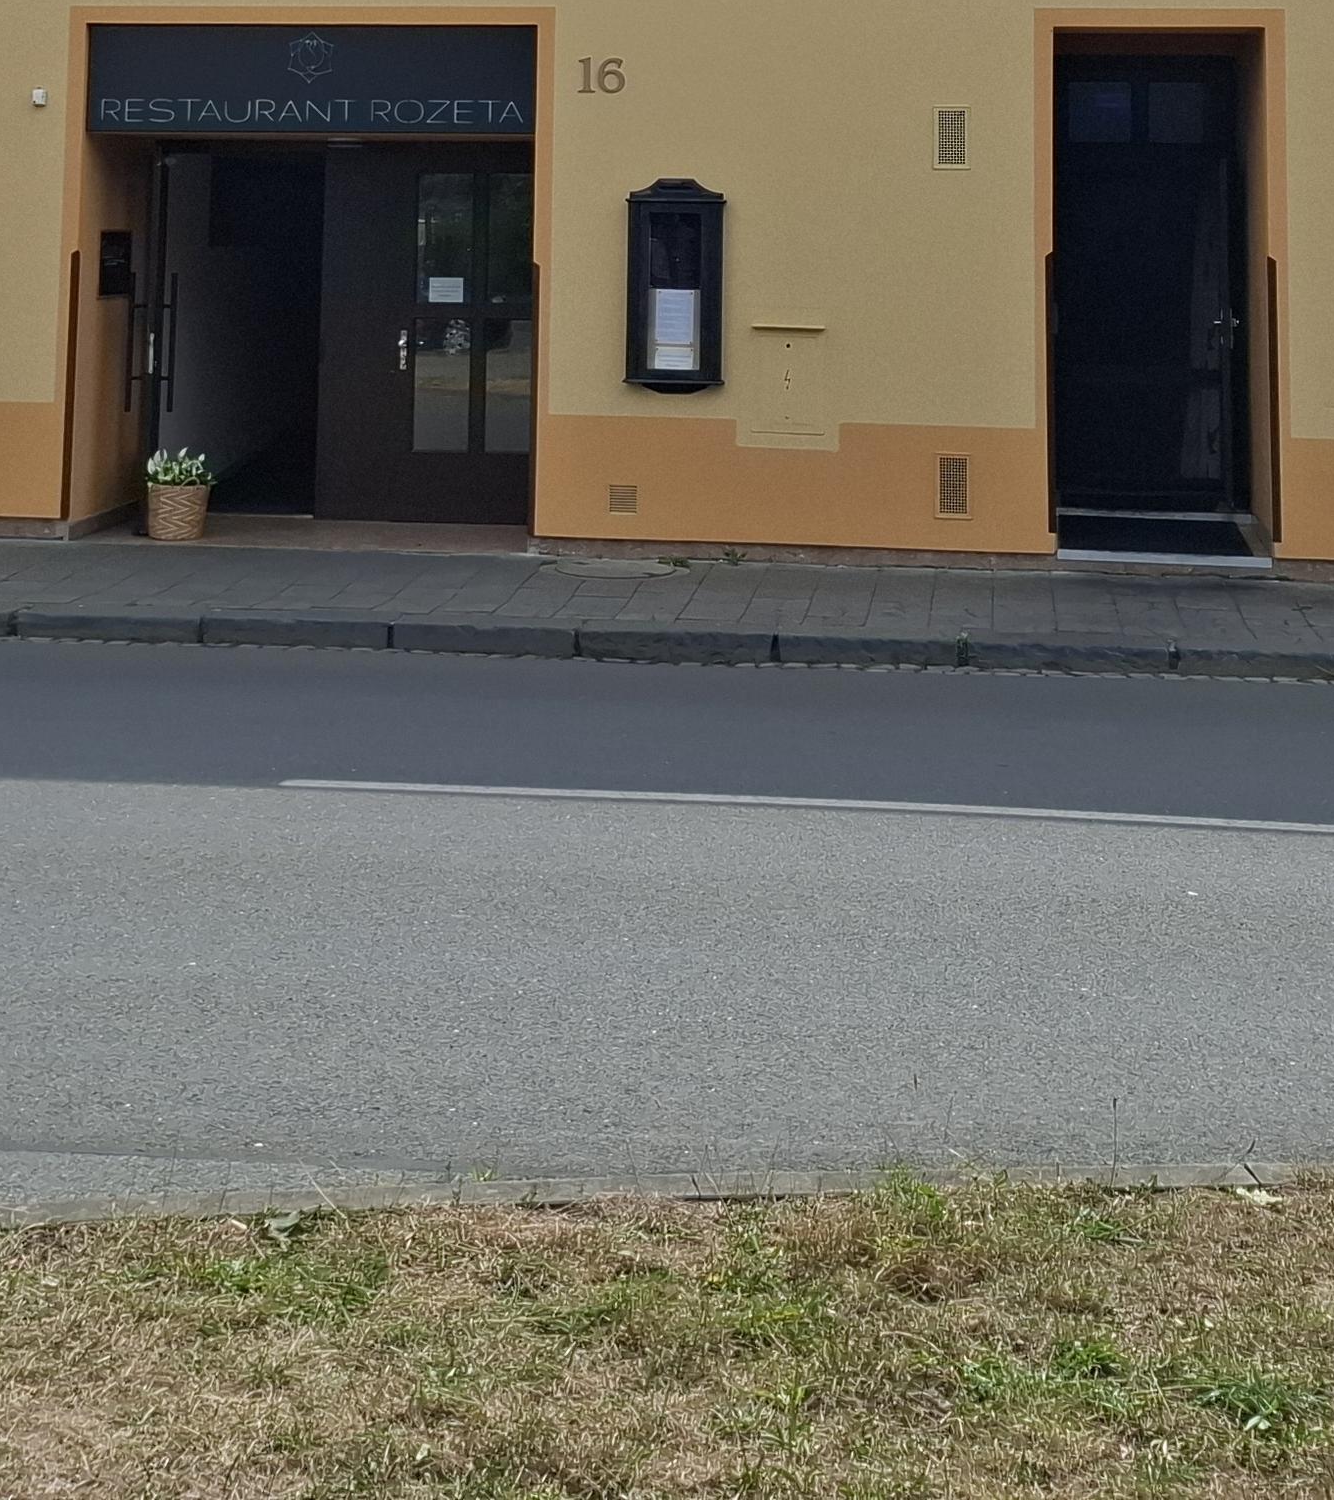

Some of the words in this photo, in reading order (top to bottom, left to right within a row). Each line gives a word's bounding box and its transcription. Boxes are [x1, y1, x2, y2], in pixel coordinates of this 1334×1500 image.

[577, 56, 626, 94] 16
[100, 98, 356, 124] RESTAURANT
[370, 99, 524, 125] ROZETA
